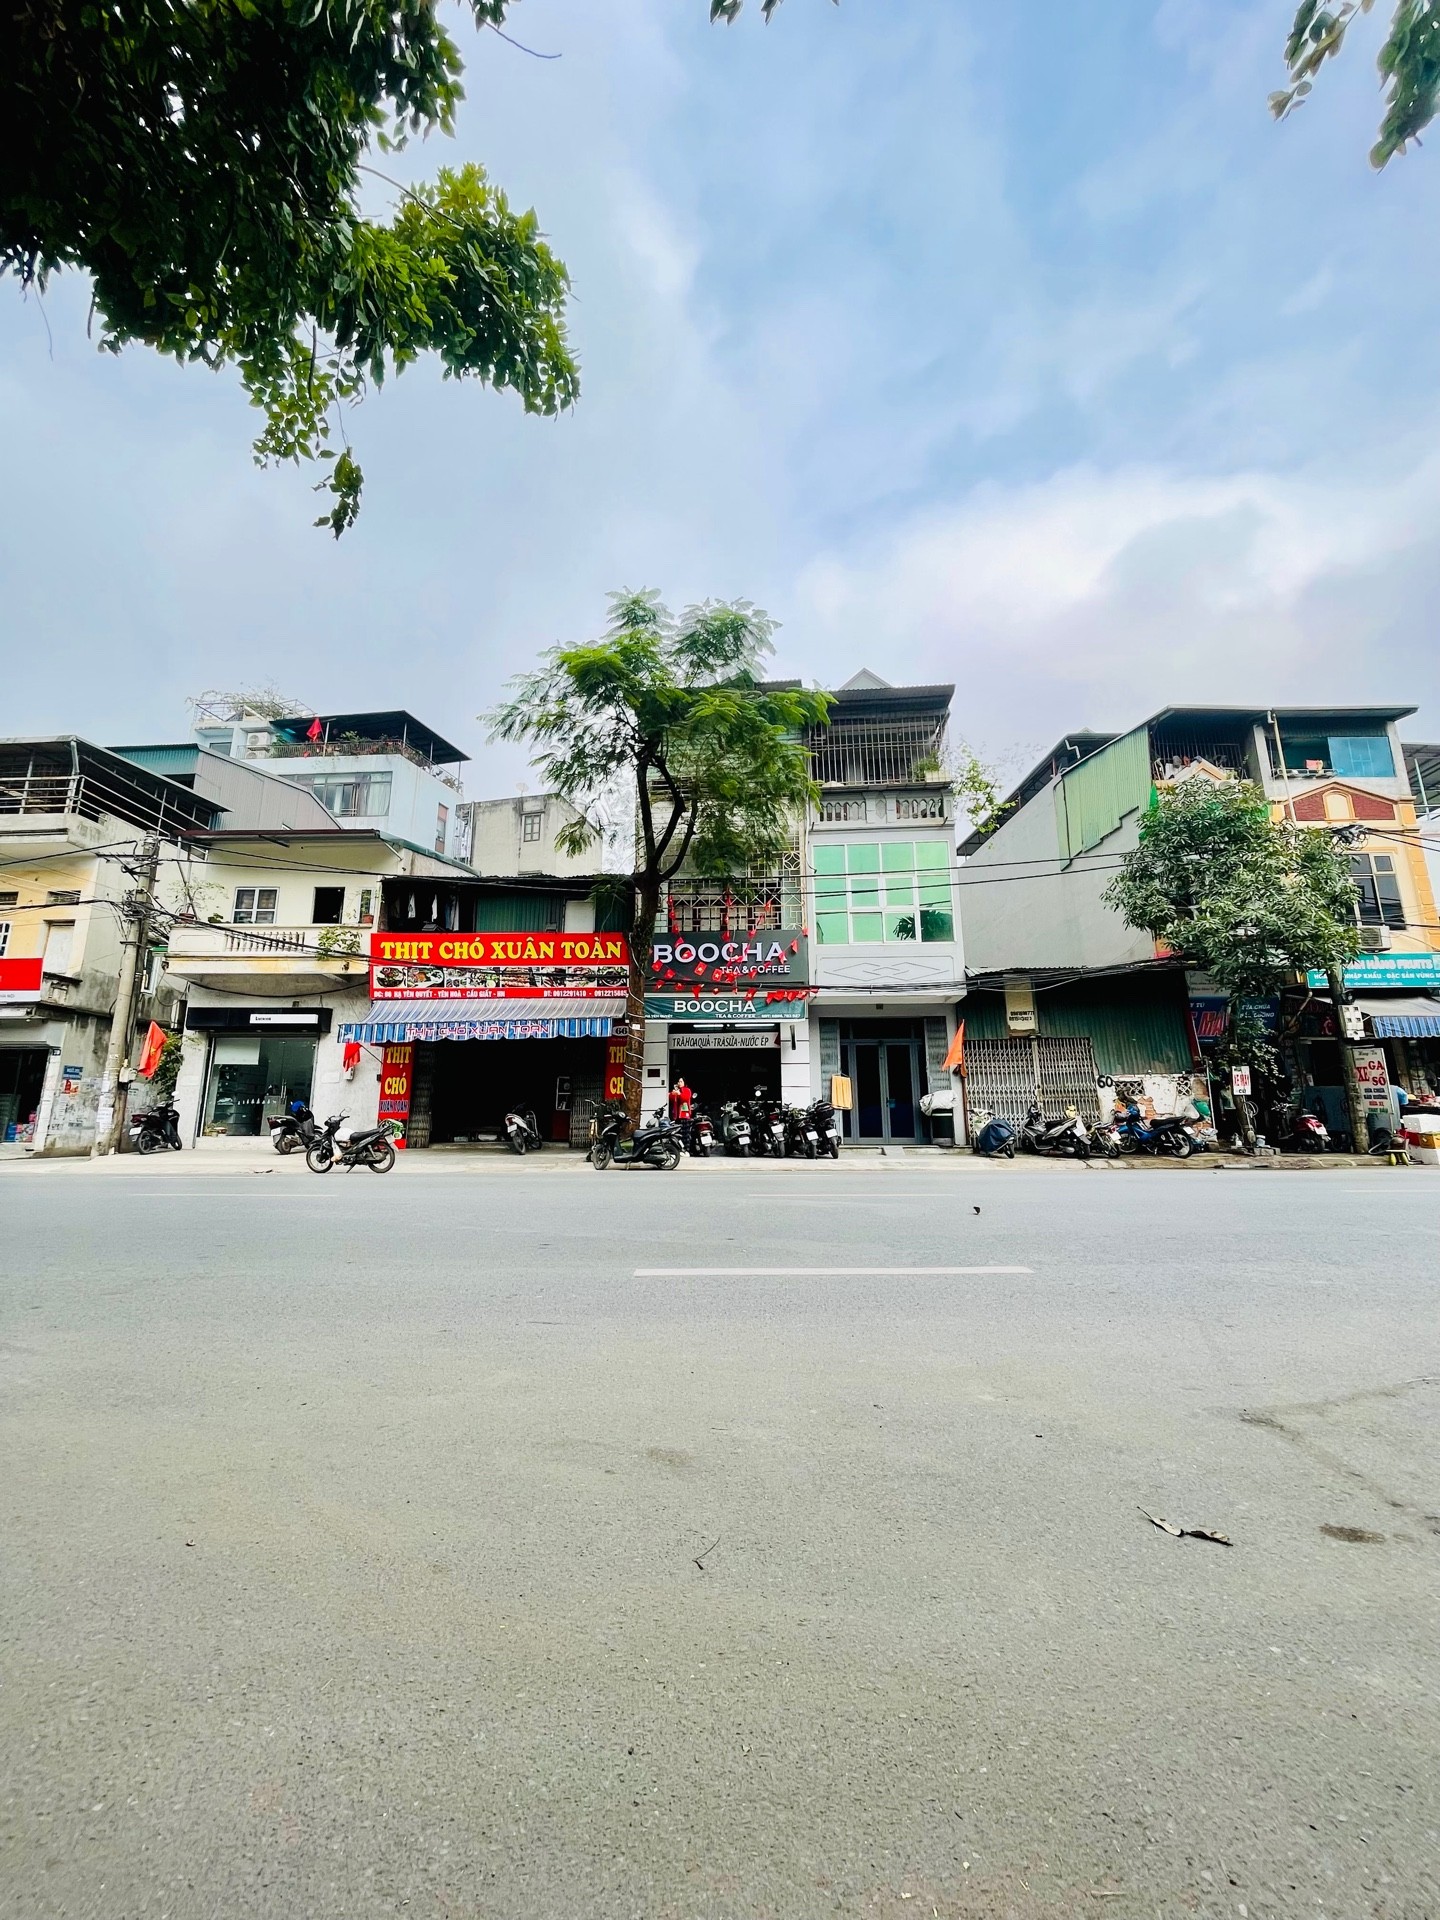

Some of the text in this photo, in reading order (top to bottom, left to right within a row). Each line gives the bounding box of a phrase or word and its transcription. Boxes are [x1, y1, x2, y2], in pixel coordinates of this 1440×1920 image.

[380, 937, 622, 962] THỊT CHÓ XUÂN TOÀN
[653, 942, 788, 963] BOOCHA
[673, 1000, 757, 1013] BOOCHA
[615, 1027, 628, 1035] 66
[1368, 1060, 1385, 1070] GA
[1097, 1074, 1113, 1088] 60
[1355, 1066, 1370, 1082] XE
[1372, 1071, 1387, 1086] SỐ
[384, 1072, 407, 1095] CHÓ
